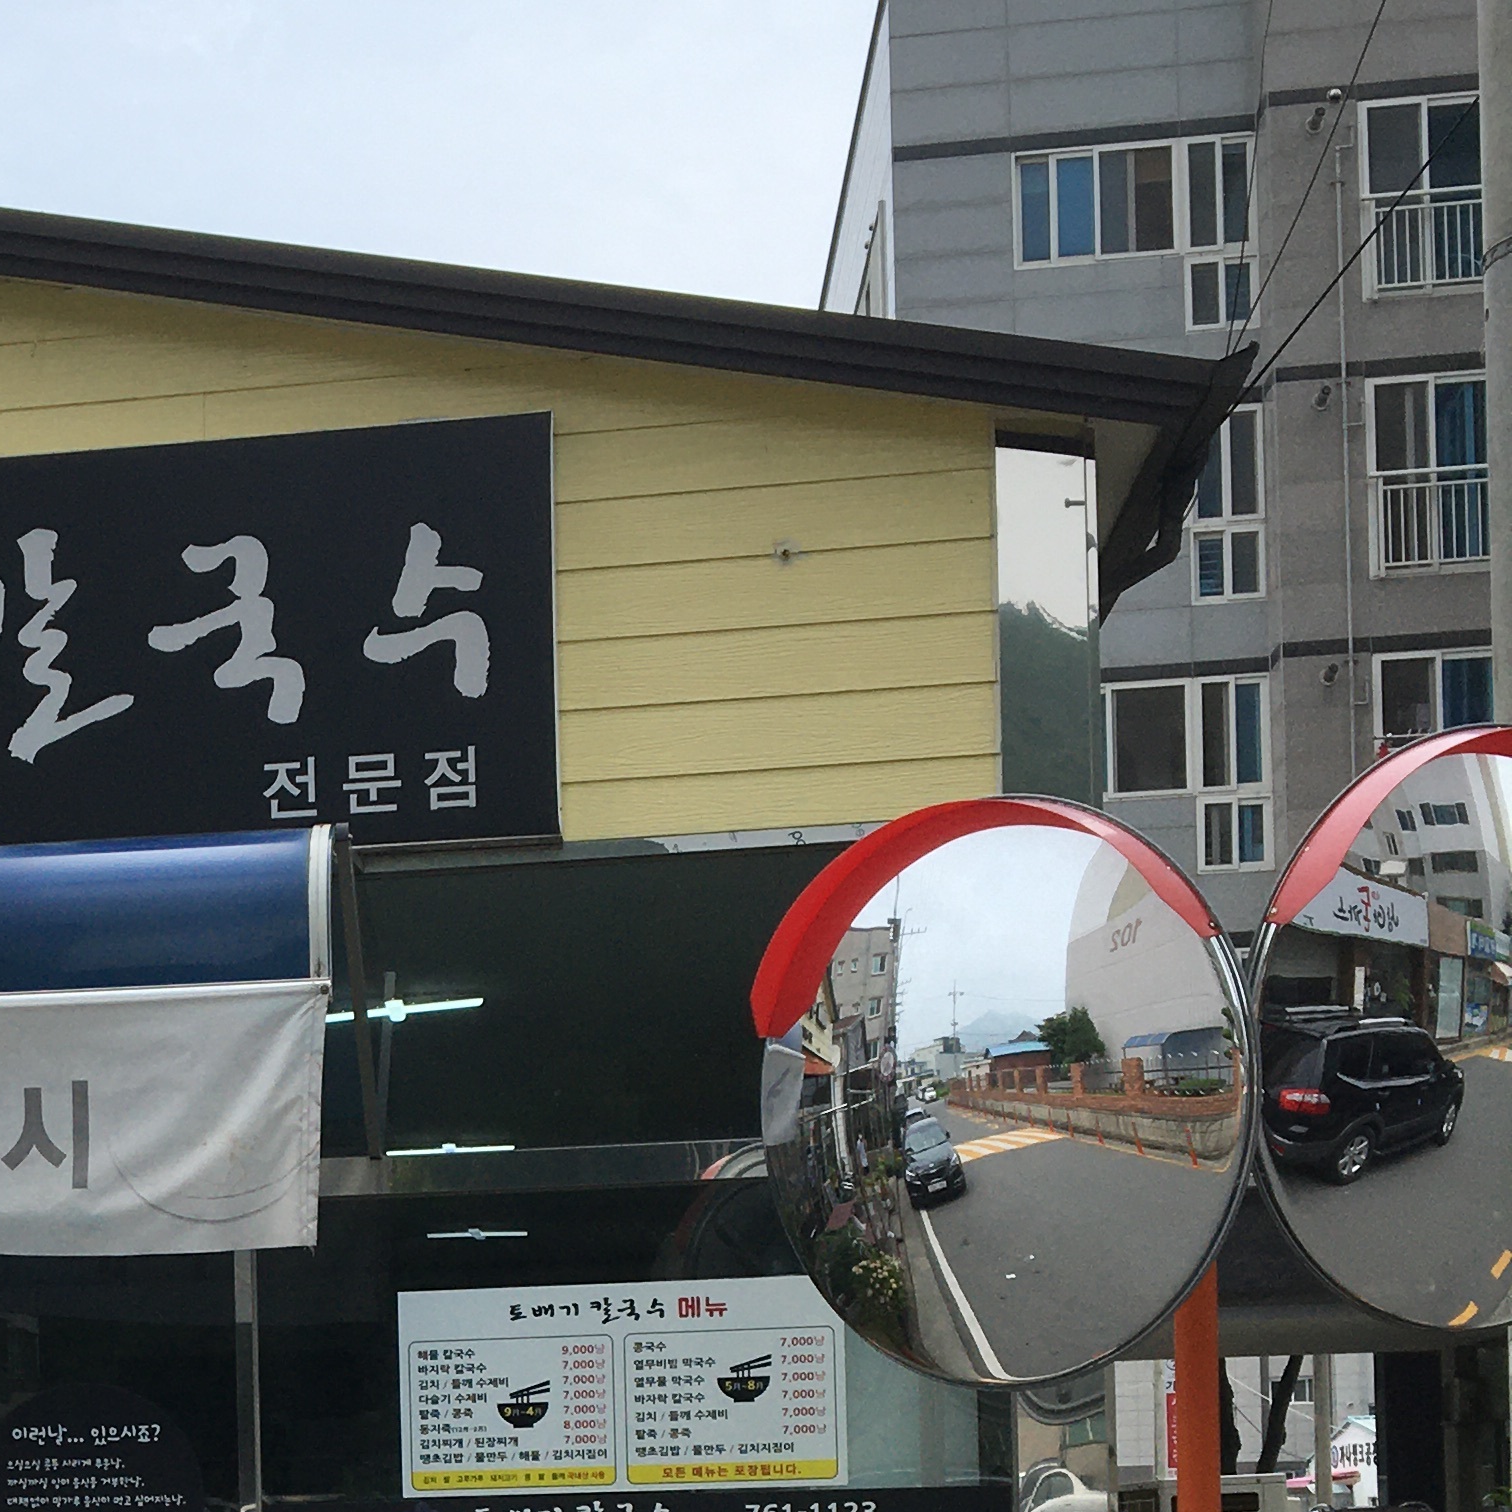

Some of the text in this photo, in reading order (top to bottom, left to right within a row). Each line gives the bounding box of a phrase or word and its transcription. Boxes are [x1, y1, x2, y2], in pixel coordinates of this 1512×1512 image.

[261, 745, 480, 820] 전문점
[509, 1296, 728, 1324] 토배기 칼국수 메뉴
[633, 1341, 667, 1353] 콩국수
[443, 1348, 476, 1360] 칼국수
[682, 1357, 716, 1368] 막국수
[418, 1364, 450, 1375] 바지락
[454, 1363, 487, 1375] 칼국수
[419, 1379, 440, 1390] 김치
[476, 1377, 509, 1388] 수제비
[671, 1375, 705, 1386] 막국수
[419, 1394, 451, 1405] 다슬기
[455, 1393, 487, 1404] 수제비
[672, 1392, 705, 1404] 칼국수
[635, 1411, 657, 1422] 김치
[694, 1408, 728, 1420] 수제비
[91, 1424, 161, 1446] 있으시죠?
[420, 1438, 463, 1449] 김치찌개
[474, 1437, 519, 1448] 된장찌개
[662, 1467, 686, 1478] 모든
[692, 1465, 728, 1478] 메뉴는
